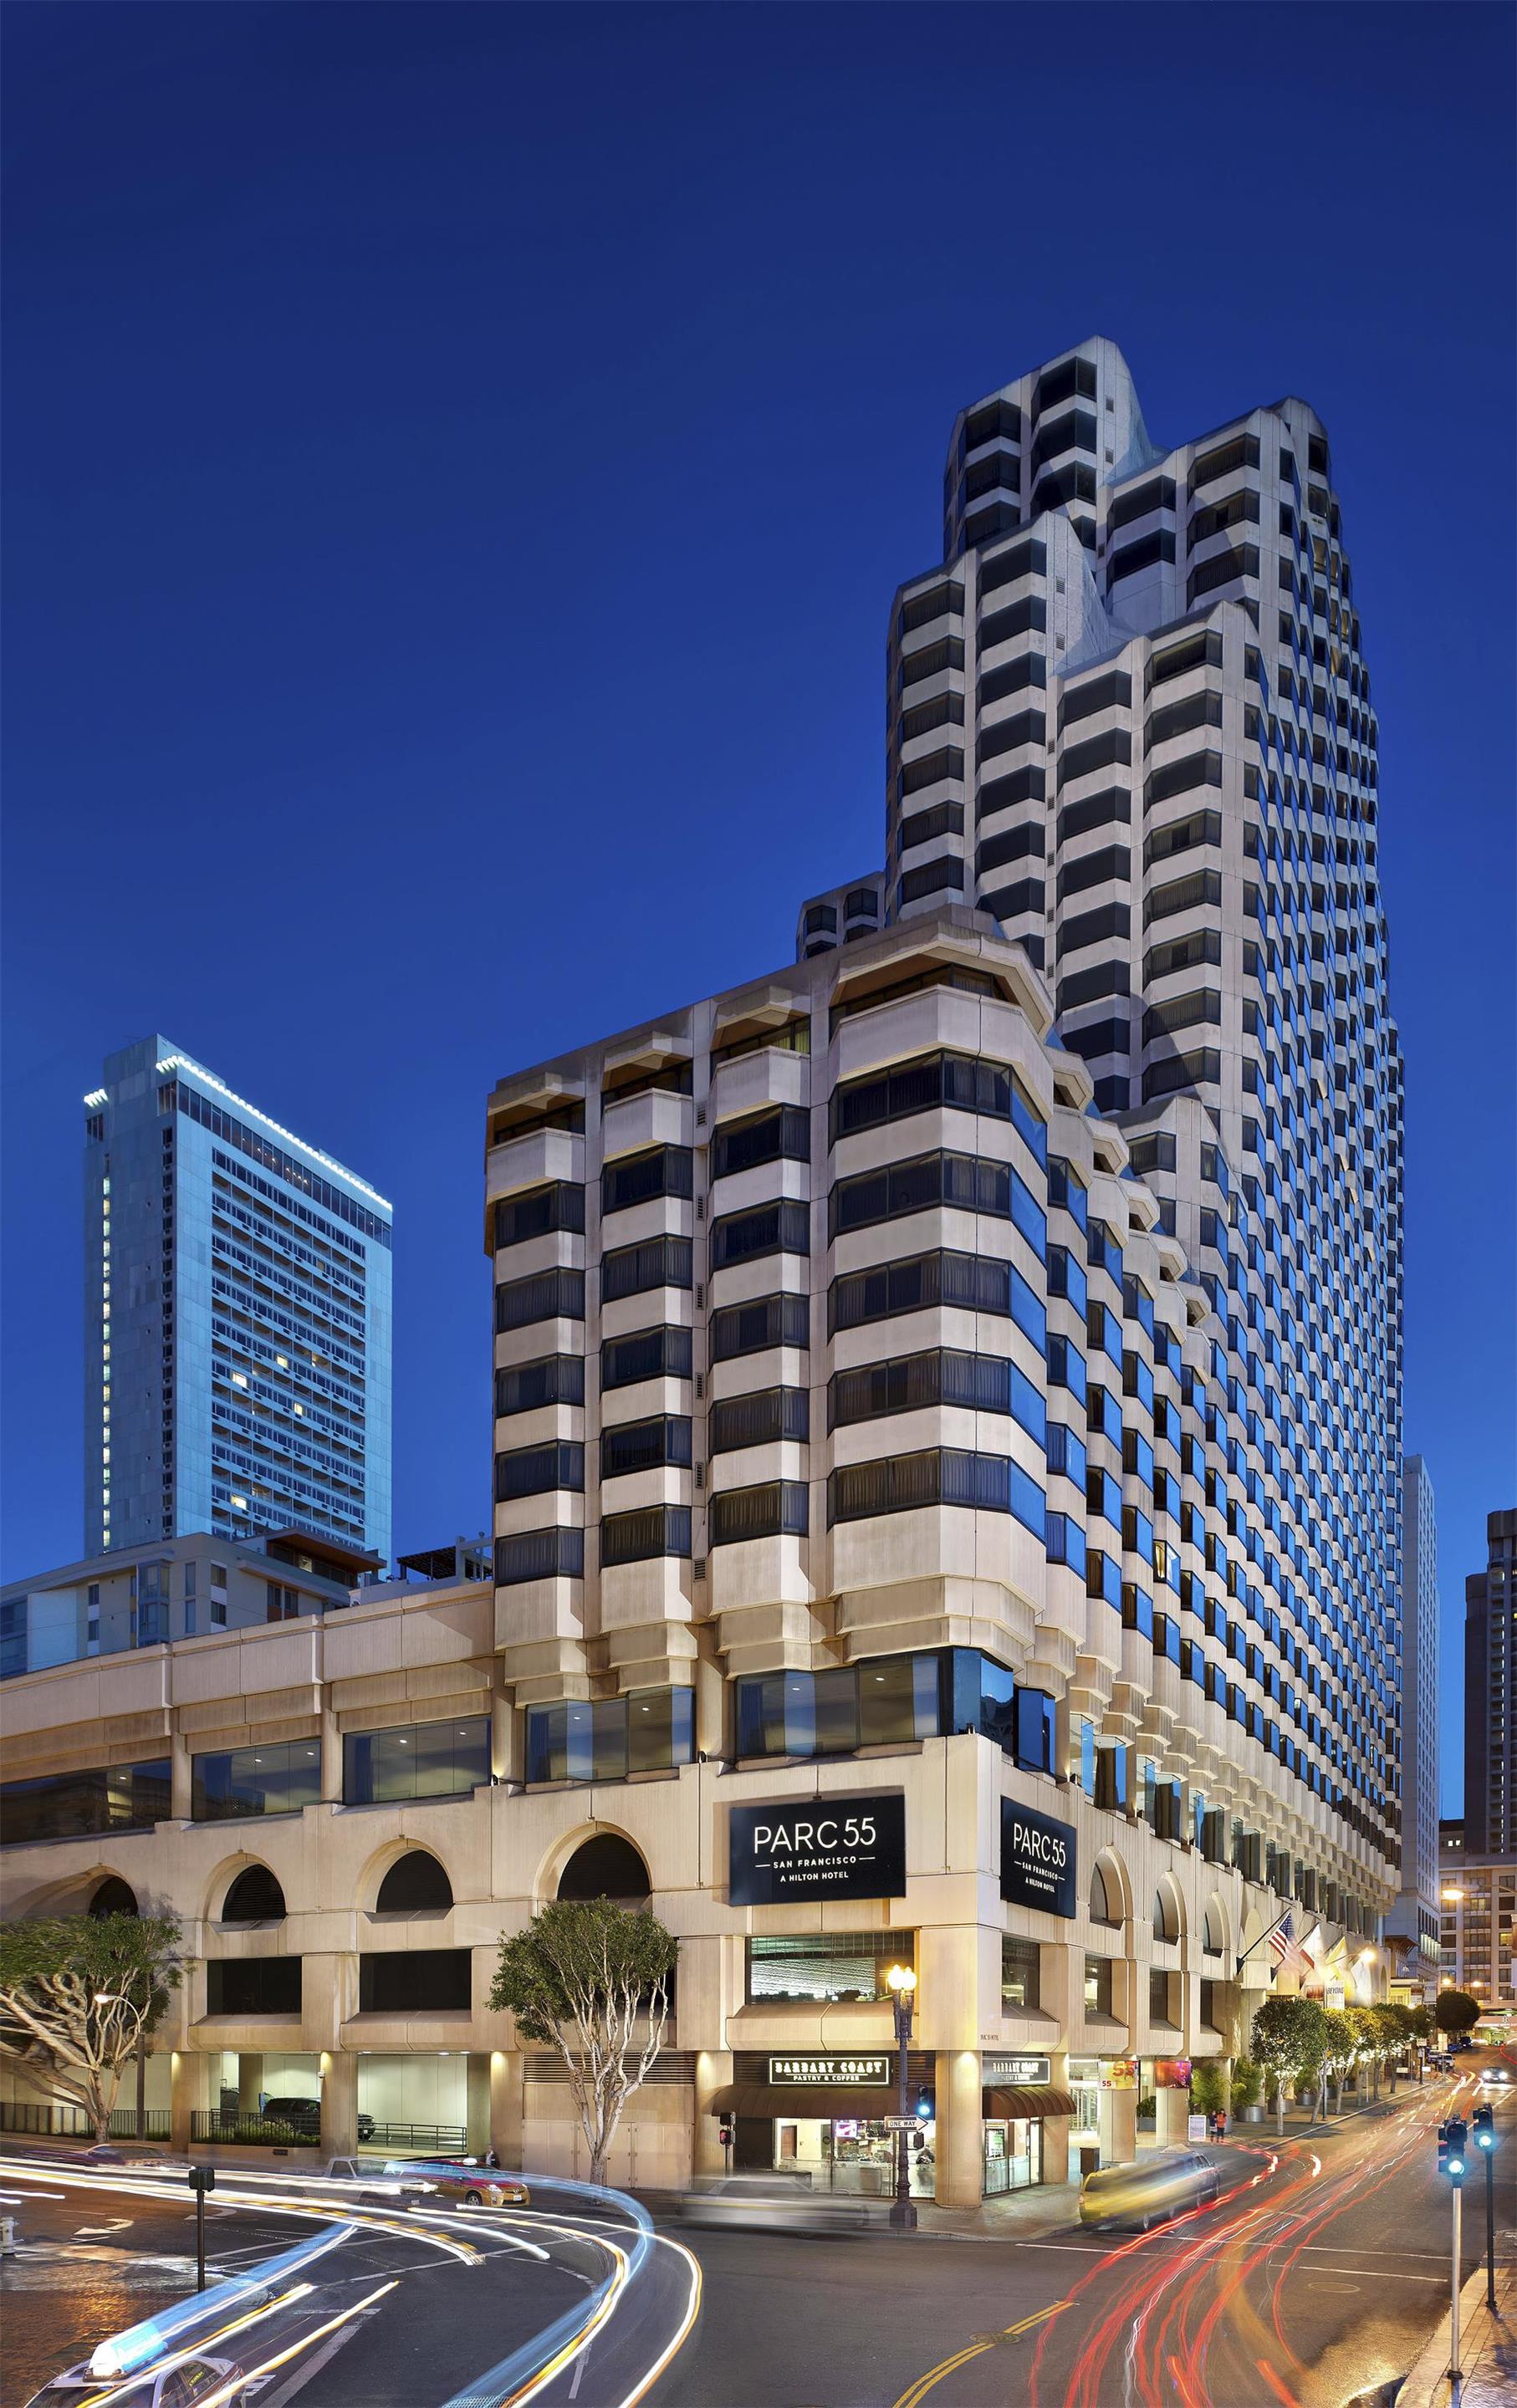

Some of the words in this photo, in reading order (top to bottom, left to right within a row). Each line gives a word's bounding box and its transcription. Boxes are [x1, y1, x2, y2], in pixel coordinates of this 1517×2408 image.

[754, 1821, 837, 1854] PARC
[843, 1817, 876, 1847] 55
[1014, 1823, 1050, 1861] PARC
[1052, 1839, 1066, 1867] 55
[773, 1860, 793, 1869] SAN
[798, 1855, 856, 1867] FRANCISCO
[789, 1873, 818, 1881] HILTON
[822, 1871, 849, 1880] HOTEL
[1022, 1862, 1032, 1871] SAN
[1033, 1865, 1058, 1880] FRANCISCO
[1029, 1878, 1043, 1889] HILTON
[774, 2061, 835, 2073] BARBARY
[840, 2061, 882, 2073] COAST
